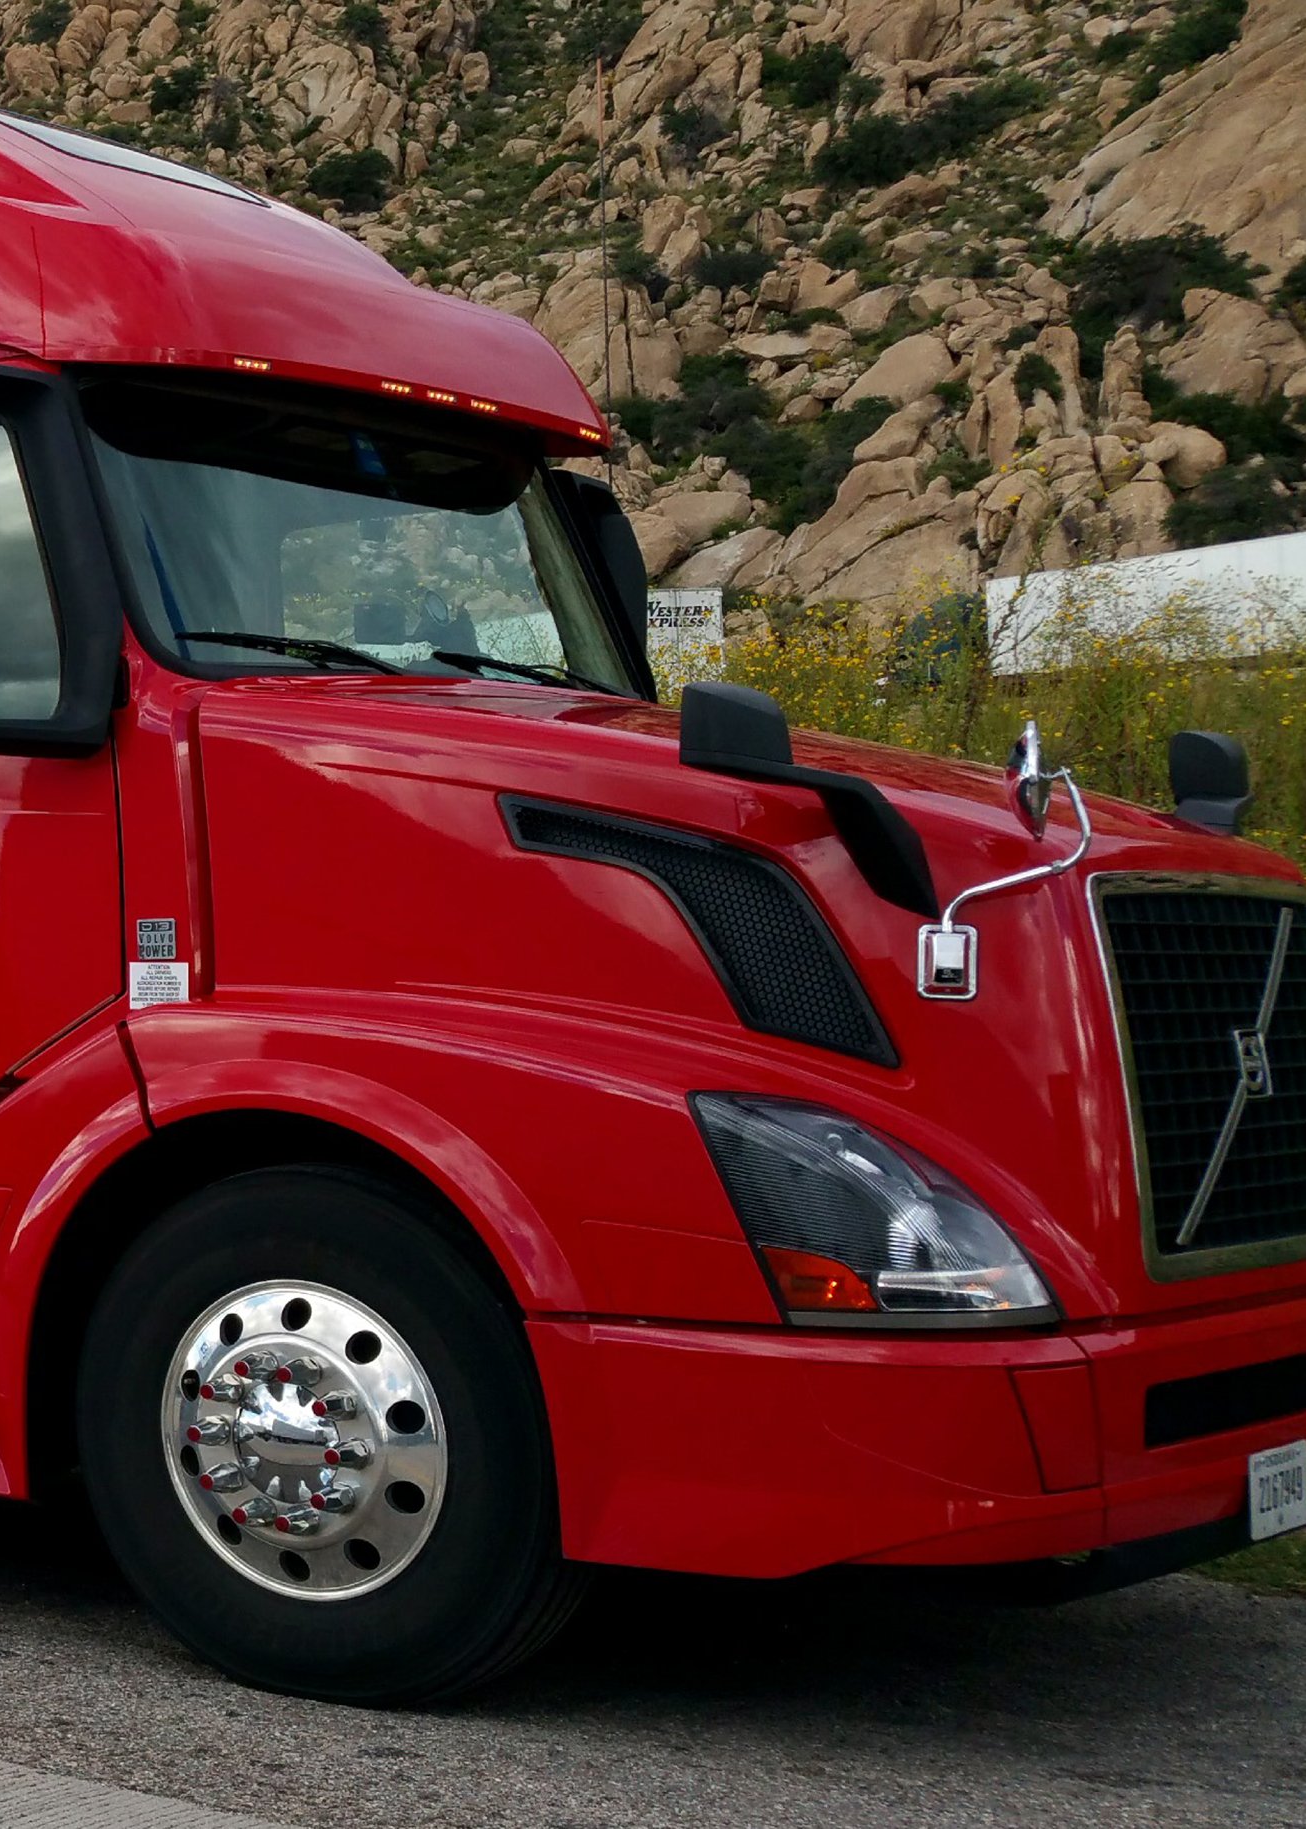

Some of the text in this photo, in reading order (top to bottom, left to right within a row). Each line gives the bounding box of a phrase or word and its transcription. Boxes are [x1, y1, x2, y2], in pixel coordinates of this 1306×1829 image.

[648, 617, 706, 628] XPRESS
[141, 922, 170, 932] D13
[138, 932, 174, 944] VOLVO
[138, 944, 175, 958] POWER
